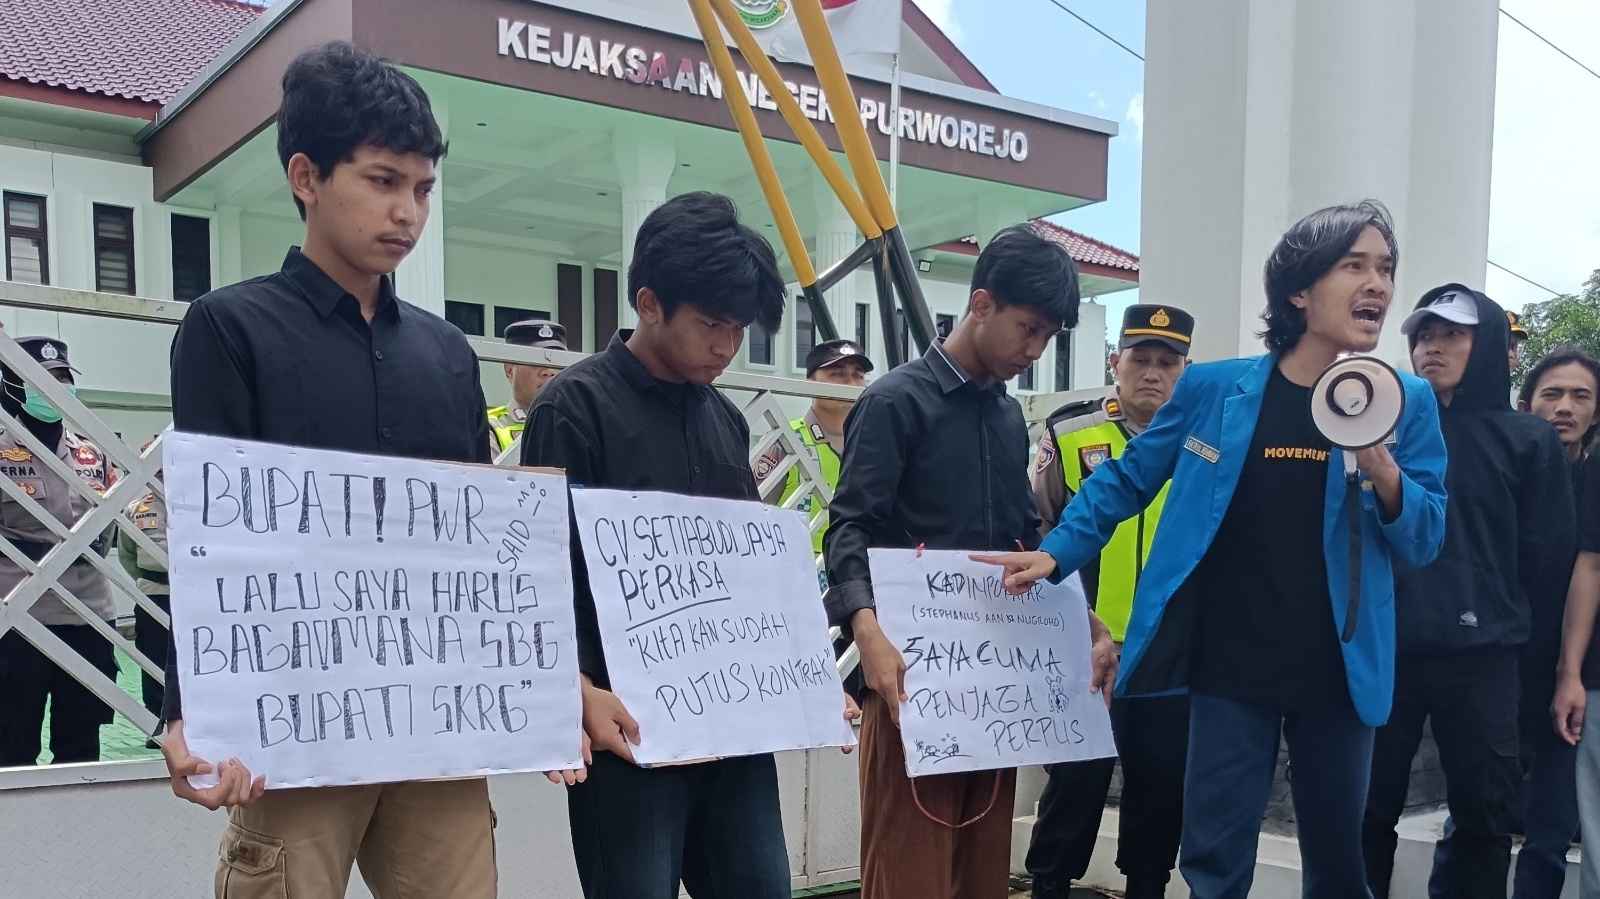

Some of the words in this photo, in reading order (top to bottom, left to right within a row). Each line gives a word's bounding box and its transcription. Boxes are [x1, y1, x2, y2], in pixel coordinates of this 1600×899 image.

[497, 18, 722, 100] KEJAKSAAN
[859, 97, 1028, 162] PURWOREJO
[1264, 447, 1330, 461] MOVEMEN
[405, 477, 490, 545] PWR
[633, 515, 739, 562] SETIABUDI
[741, 521, 788, 557] JAYA
[216, 570, 320, 614] LALU
[333, 568, 411, 612] SAYA
[432, 570, 539, 614] HARUS
[617, 560, 729, 621] PERKASA
[480, 620, 560, 670] SBG
[688, 616, 719, 653] KAN
[721, 612, 790, 644] SUDAH
[903, 636, 974, 676] SAYA
[976, 640, 1066, 677] CUMA
[655, 662, 751, 722] PUTUS
[909, 680, 1038, 720] PENJAGA
[256, 684, 413, 748] BUPATI
[985, 716, 1086, 756] PERPUS
